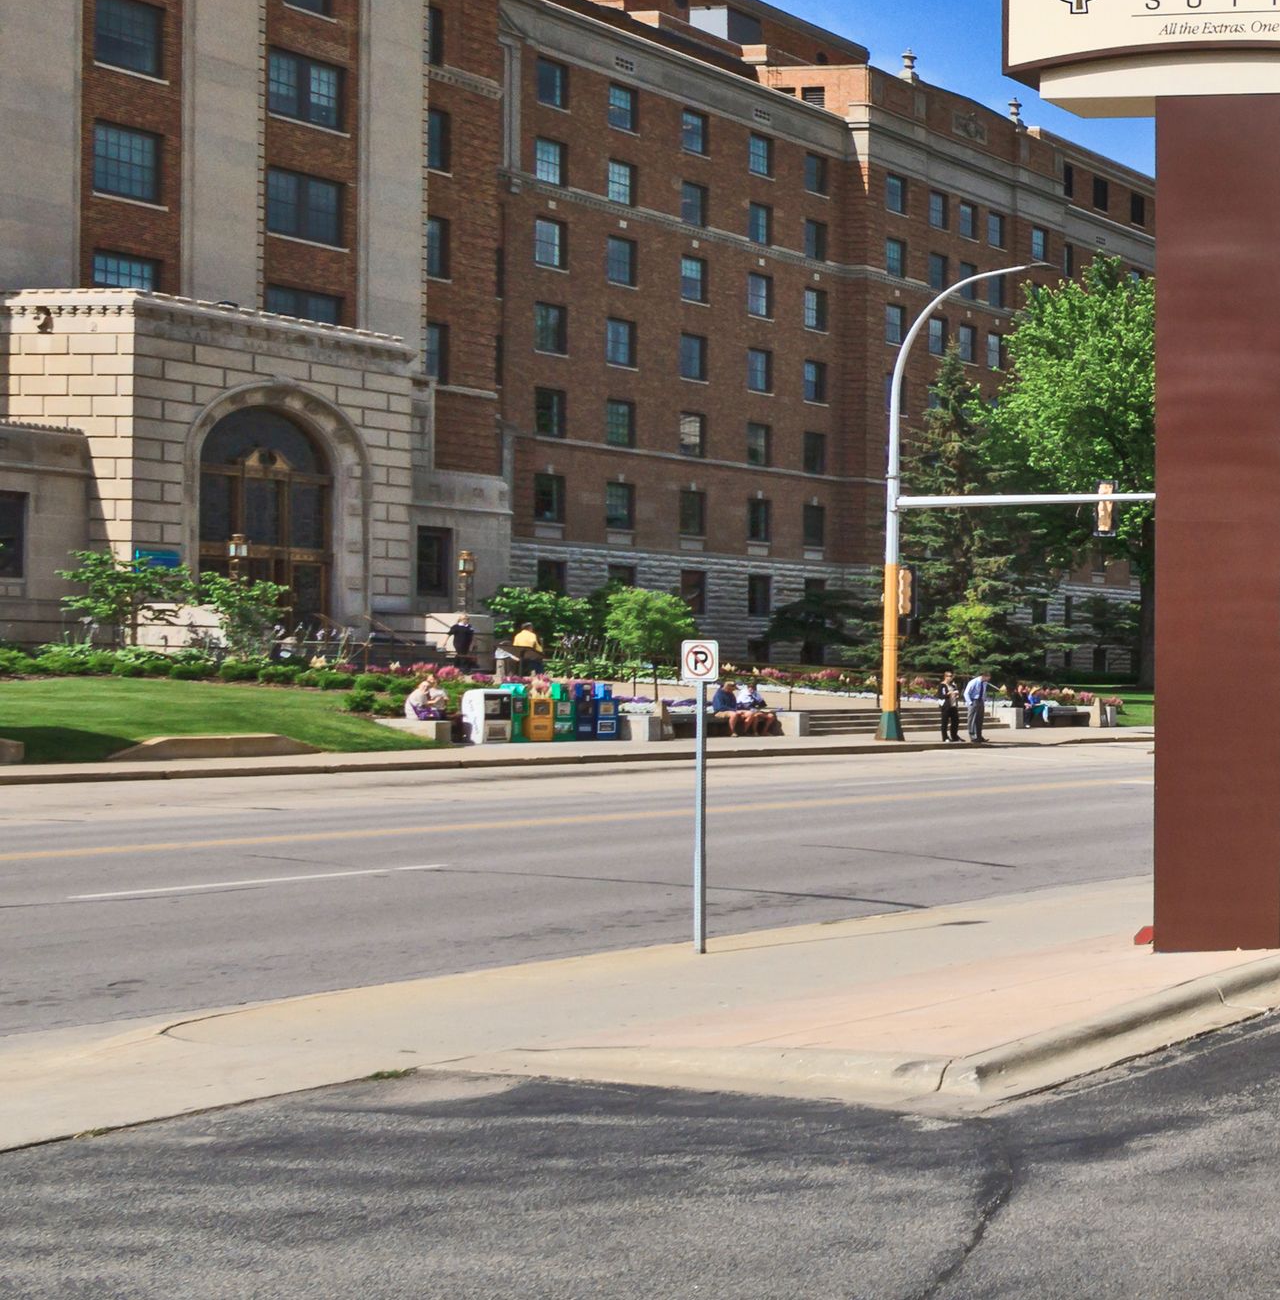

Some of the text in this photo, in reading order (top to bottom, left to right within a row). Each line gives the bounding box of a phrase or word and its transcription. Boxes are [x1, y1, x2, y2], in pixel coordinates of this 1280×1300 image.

[1159, 23, 1177, 36] All
[1178, 22, 1200, 35] the
[1202, 21, 1247, 35] Extras.
[1250, 20, 1280, 34] One
